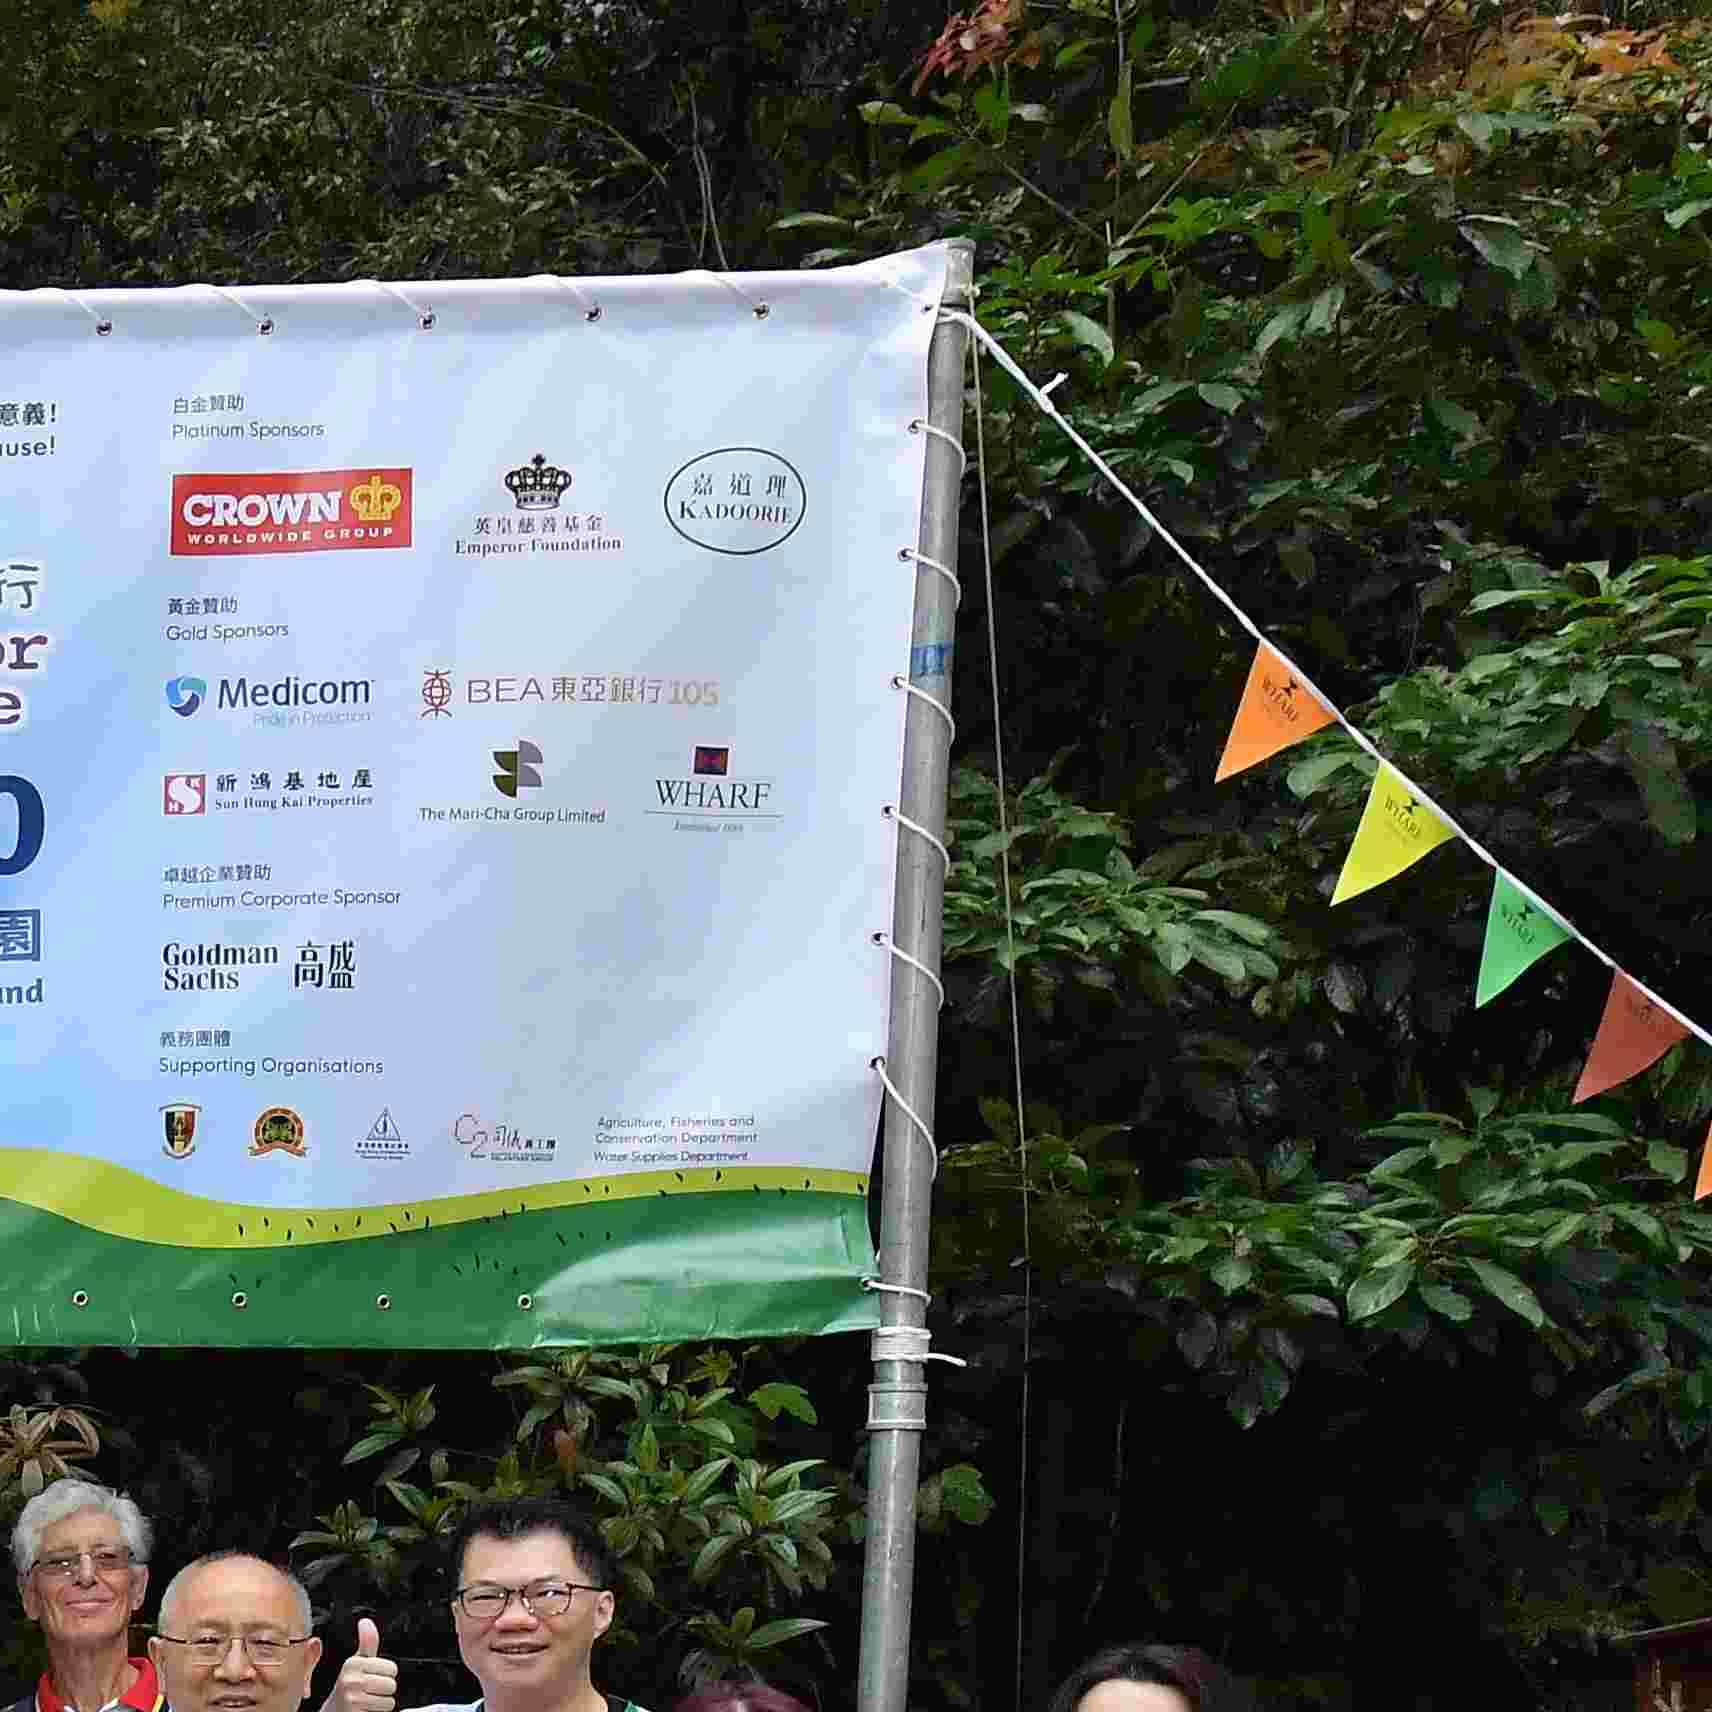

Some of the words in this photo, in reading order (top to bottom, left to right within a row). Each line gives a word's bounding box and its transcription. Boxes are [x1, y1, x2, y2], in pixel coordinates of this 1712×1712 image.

[172, 423, 244, 439] Platinum
[249, 421, 326, 440] Sponsors
[182, 490, 342, 527] CROWN
[678, 500, 793, 524] KADOORIE
[187, 530, 313, 545] WORLDWIDE
[324, 527, 394, 540] GROUP
[454, 538, 525, 558] Emperor
[530, 536, 624, 553] Foundation
[165, 624, 208, 641] Gold
[212, 623, 289, 644] Sponsors
[217, 676, 371, 710] Medicom
[467, 678, 544, 703] BEA
[551, 676, 662, 704] 東亞銀行
[215, 798, 239, 810] Sun
[244, 797, 276, 813] Hung
[281, 797, 303, 809] Kai
[307, 794, 374, 810] Properties
[655, 779, 772, 809] WHARF
[420, 808, 446, 821] The
[449, 807, 511, 822] Mari-Cha
[513, 808, 555, 825] Group
[558, 808, 606, 824] Limited
[162, 892, 236, 909] Premium
[240, 889, 329, 910] Corporate
[333, 888, 402, 908] Sponsor
[162, 943, 279, 966] Goldman
[293, 938, 356, 990] 高盛
[163, 967, 240, 991] Sachs
[159, 1057, 256, 1077] Supporting
[261, 1056, 384, 1077] Organisations
[729, 1115, 756, 1128] and
[680, 1131, 759, 1146] Department
[592, 1150, 627, 1162] Water
[630, 1150, 679, 1164] Supplies
[679, 1150, 751, 1163] Department
